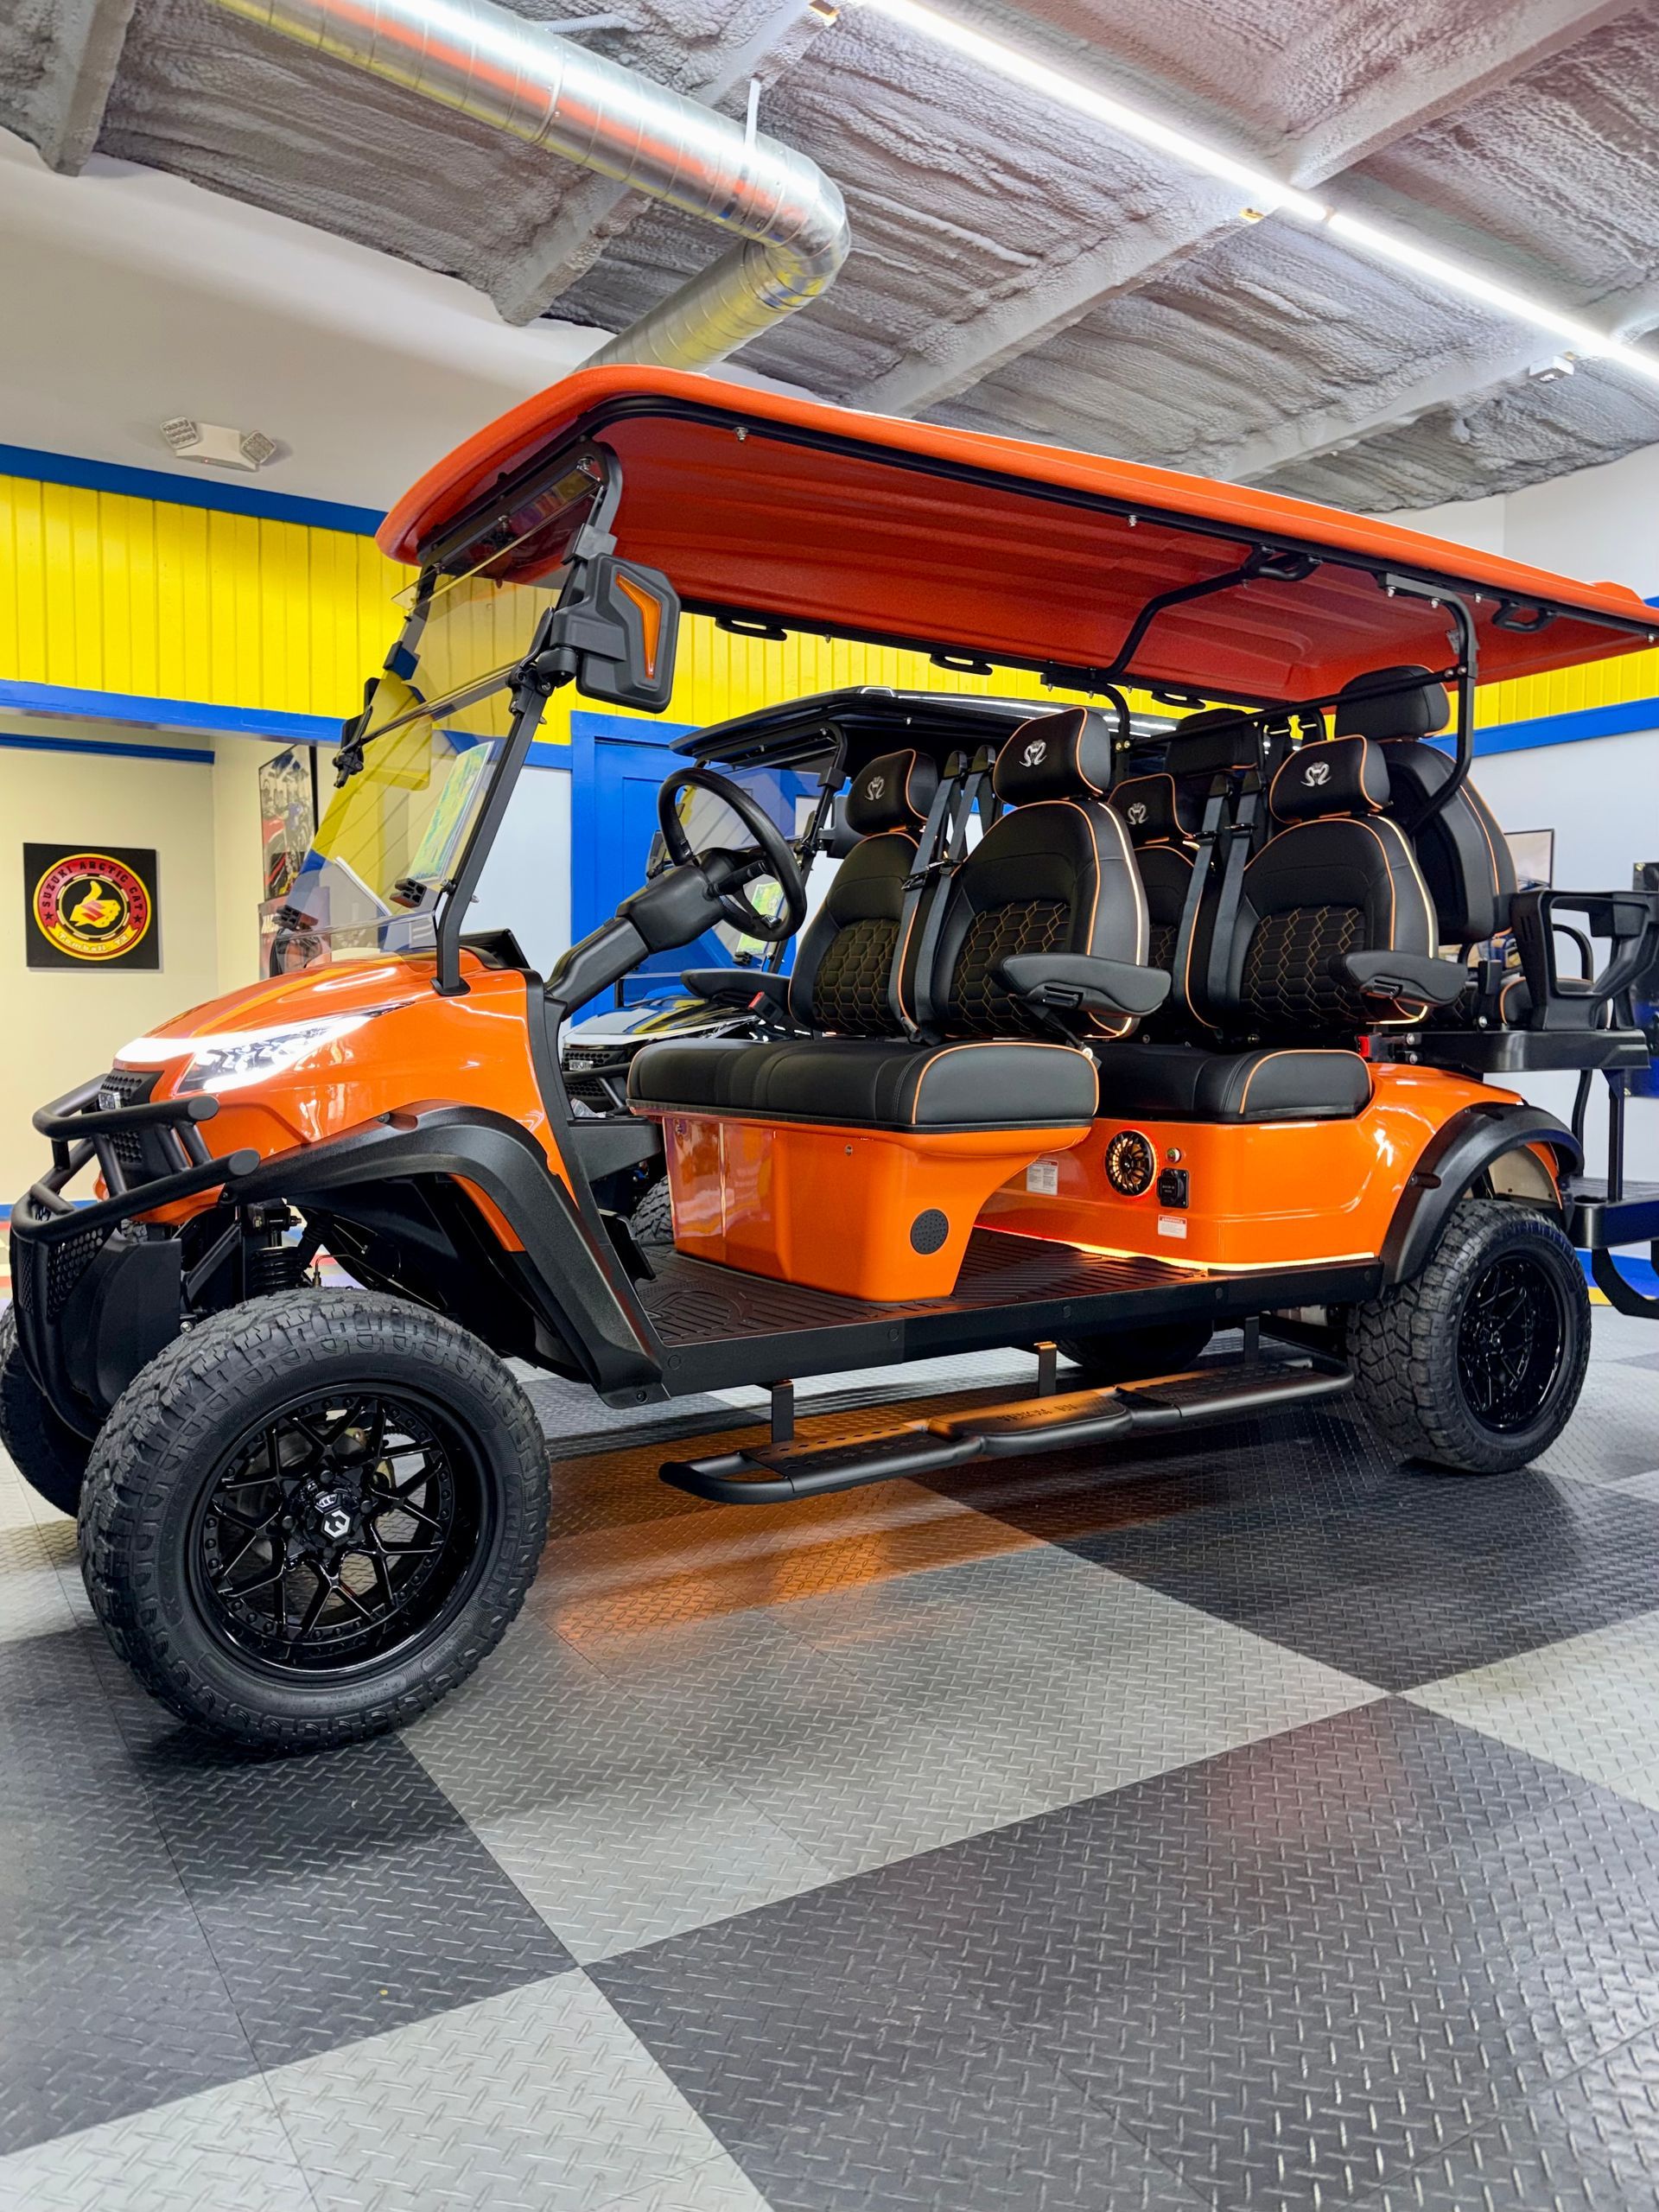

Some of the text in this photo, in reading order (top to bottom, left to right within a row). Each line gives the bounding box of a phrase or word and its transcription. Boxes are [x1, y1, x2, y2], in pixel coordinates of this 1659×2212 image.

[42, 861, 143, 911] SUZUKI ARCTIC CAT
[114, 934, 129, 945] TX
[480, 1484, 524, 1605] ARISUN
